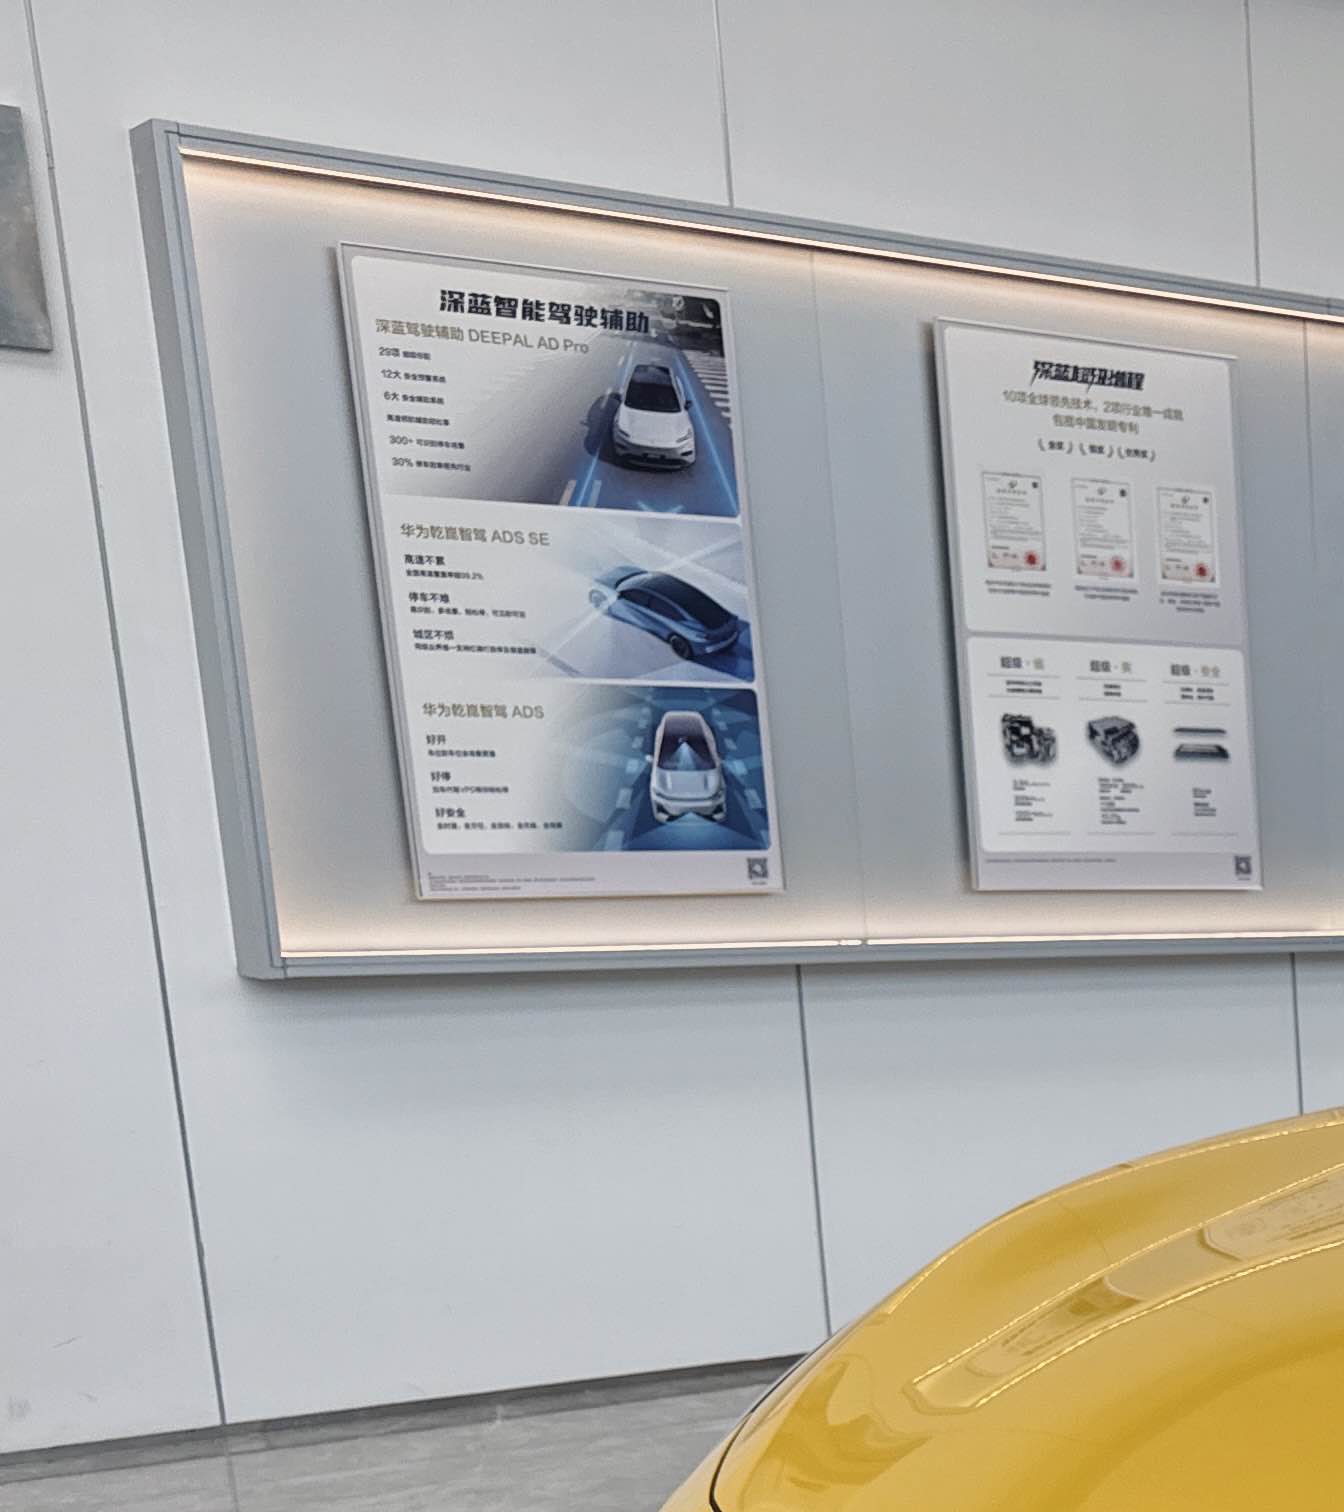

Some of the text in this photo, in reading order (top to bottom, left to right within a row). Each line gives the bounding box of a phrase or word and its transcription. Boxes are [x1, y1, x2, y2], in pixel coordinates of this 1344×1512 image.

[439, 288, 650, 334] 深蓝智能驾驶辅助
[375, 317, 590, 354] 深蓝驾驶辅助 DEEPAL AD Pro
[400, 522, 551, 546] 华为乾崑智驾 ADS SE
[422, 702, 545, 720] 华为乾崑智驾 ADS
